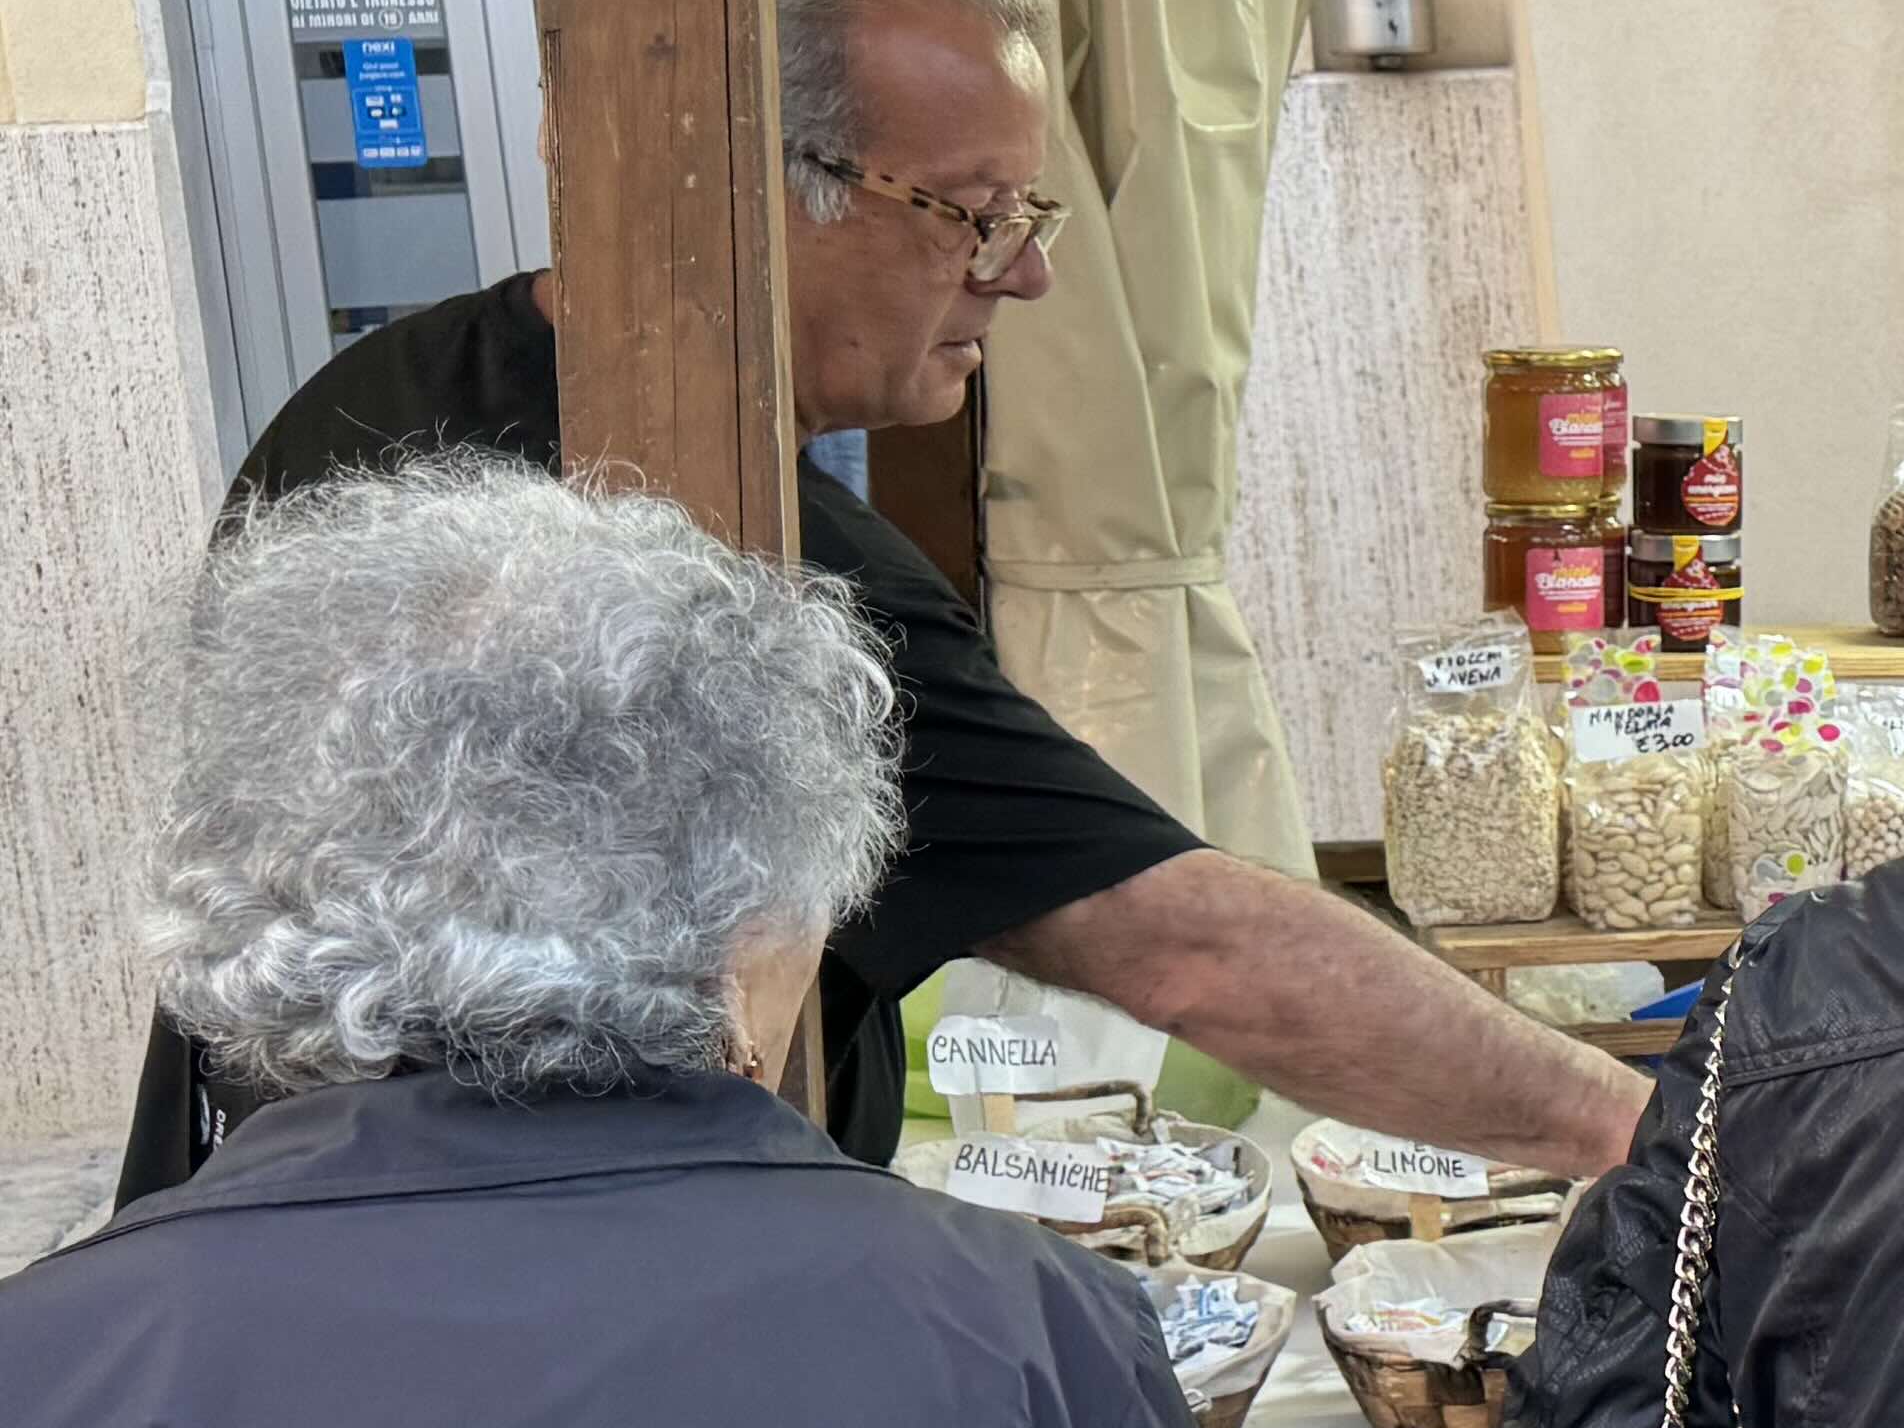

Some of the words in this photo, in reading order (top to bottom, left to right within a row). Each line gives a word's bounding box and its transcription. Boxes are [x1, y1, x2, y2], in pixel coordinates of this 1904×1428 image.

[362, 40, 395, 55] nexi
[932, 1034, 1057, 1067] CANNELLA
[1374, 1149, 1467, 1178] LIMONE
